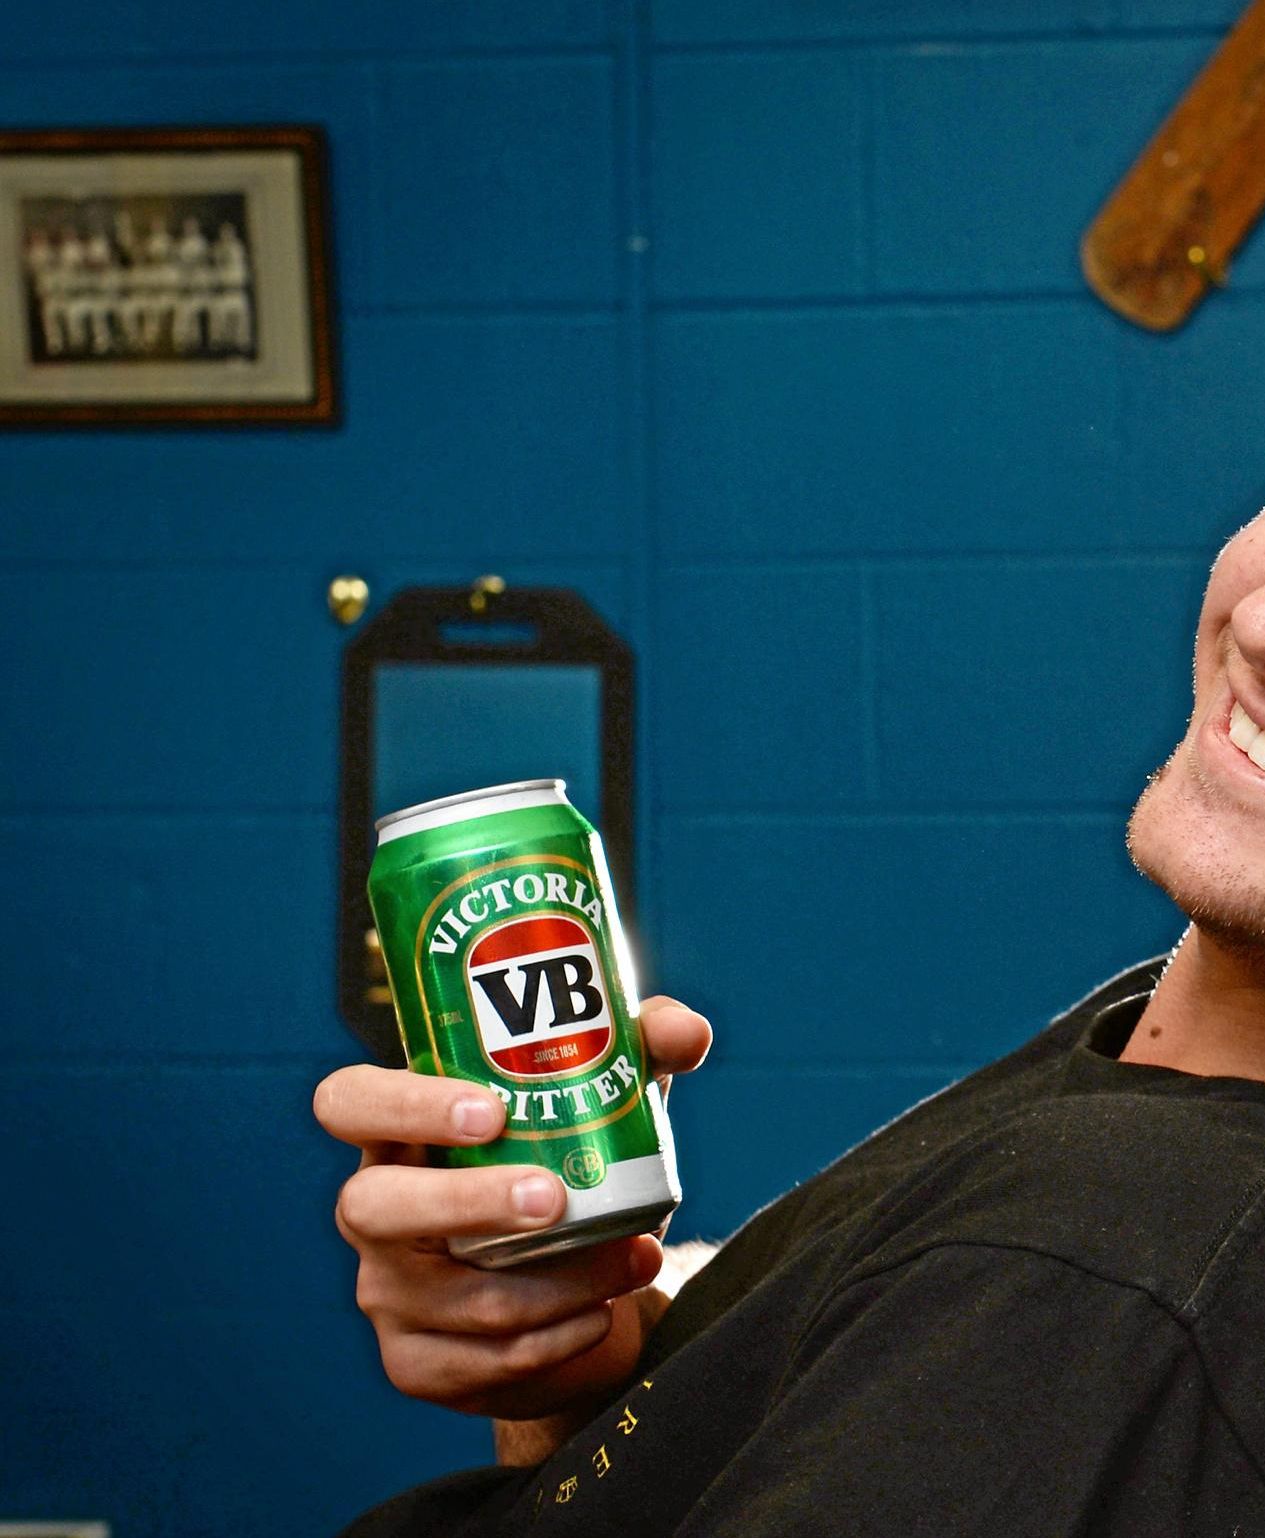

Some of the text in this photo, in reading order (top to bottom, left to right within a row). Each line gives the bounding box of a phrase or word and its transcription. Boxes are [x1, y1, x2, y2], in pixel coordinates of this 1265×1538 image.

[429, 873, 603, 955] VICTORIA
[472, 954, 604, 1037] VB
[533, 1042, 579, 1063] SINCE 1854
